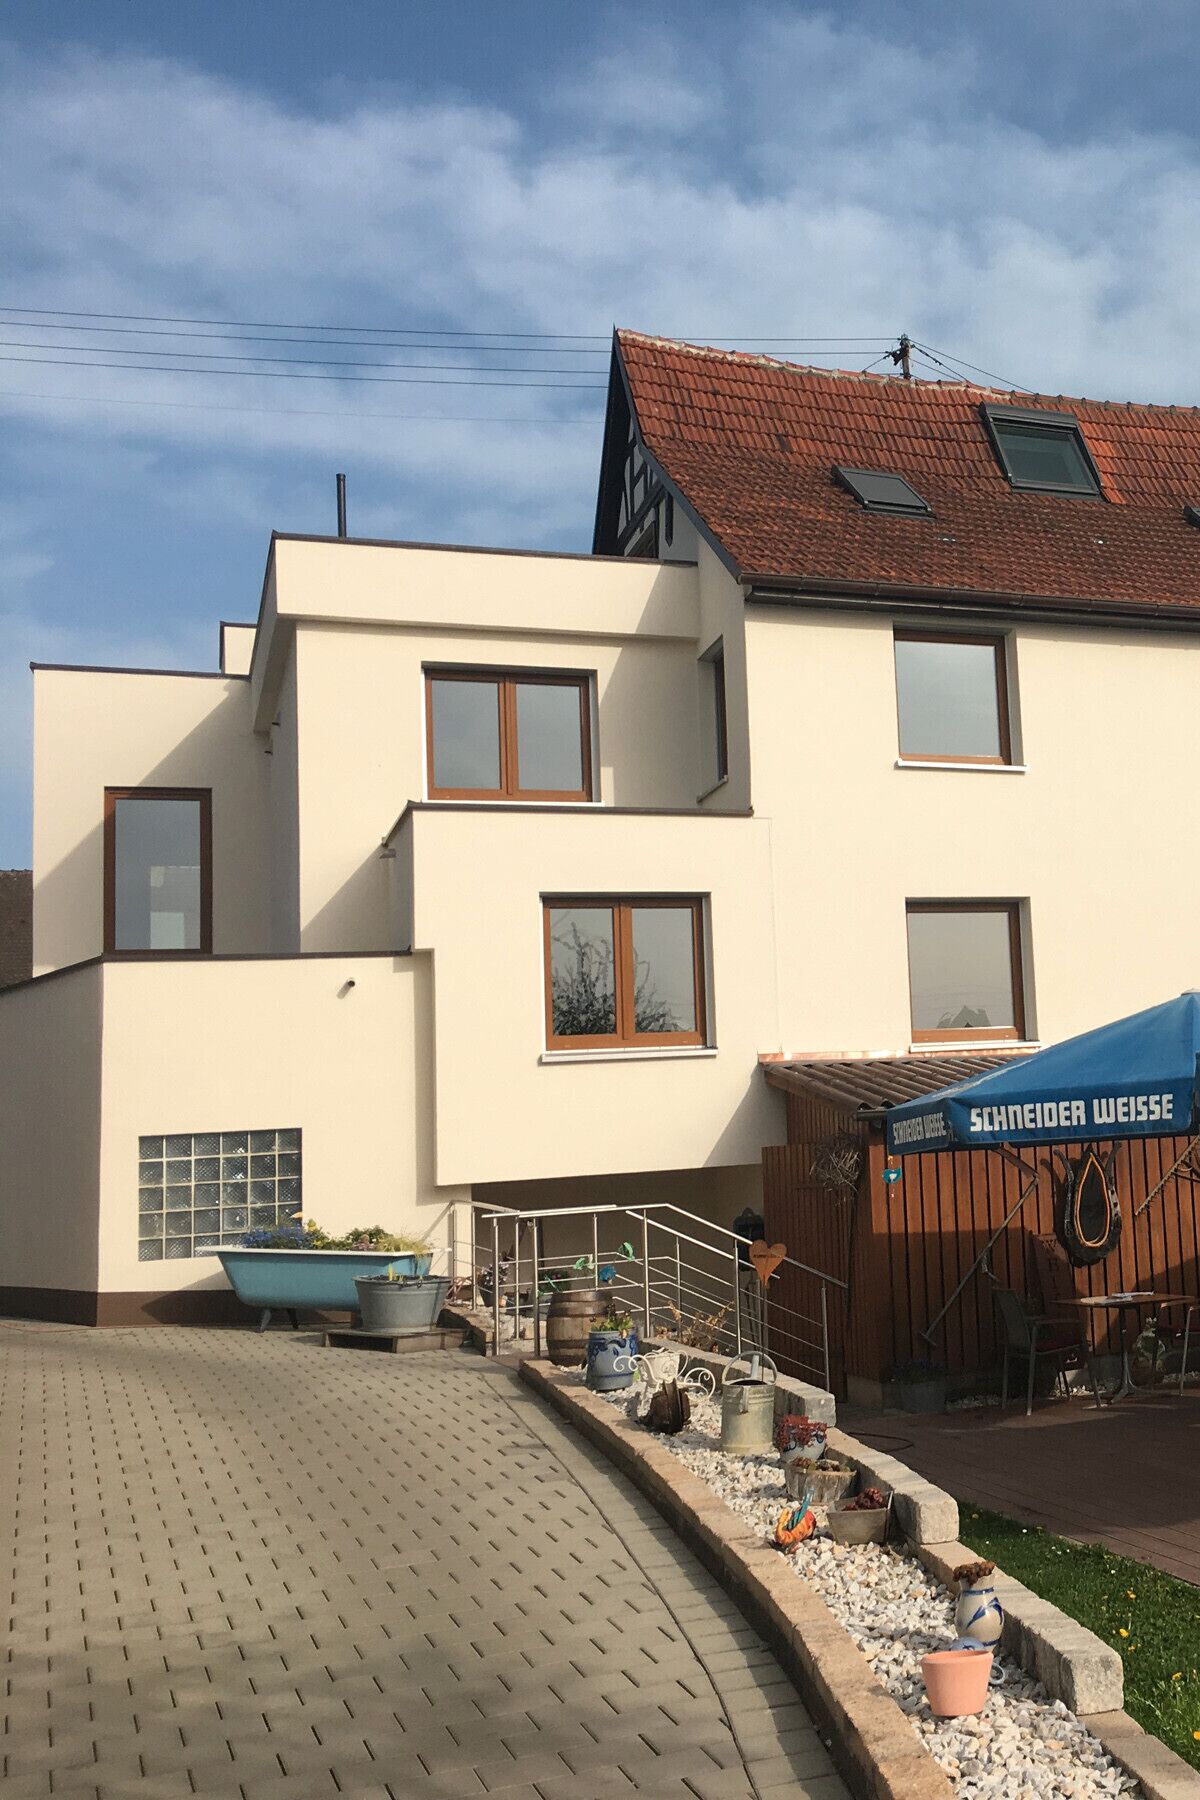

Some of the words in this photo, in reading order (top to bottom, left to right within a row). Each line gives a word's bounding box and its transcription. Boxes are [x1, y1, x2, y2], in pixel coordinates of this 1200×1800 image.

[893, 1117, 925, 1145] SCHNEIDER
[923, 1112, 947, 1139] WEISSE
[970, 1100, 1086, 1132] SCHNEIDER
[1093, 1093, 1174, 1125] WEISSE
